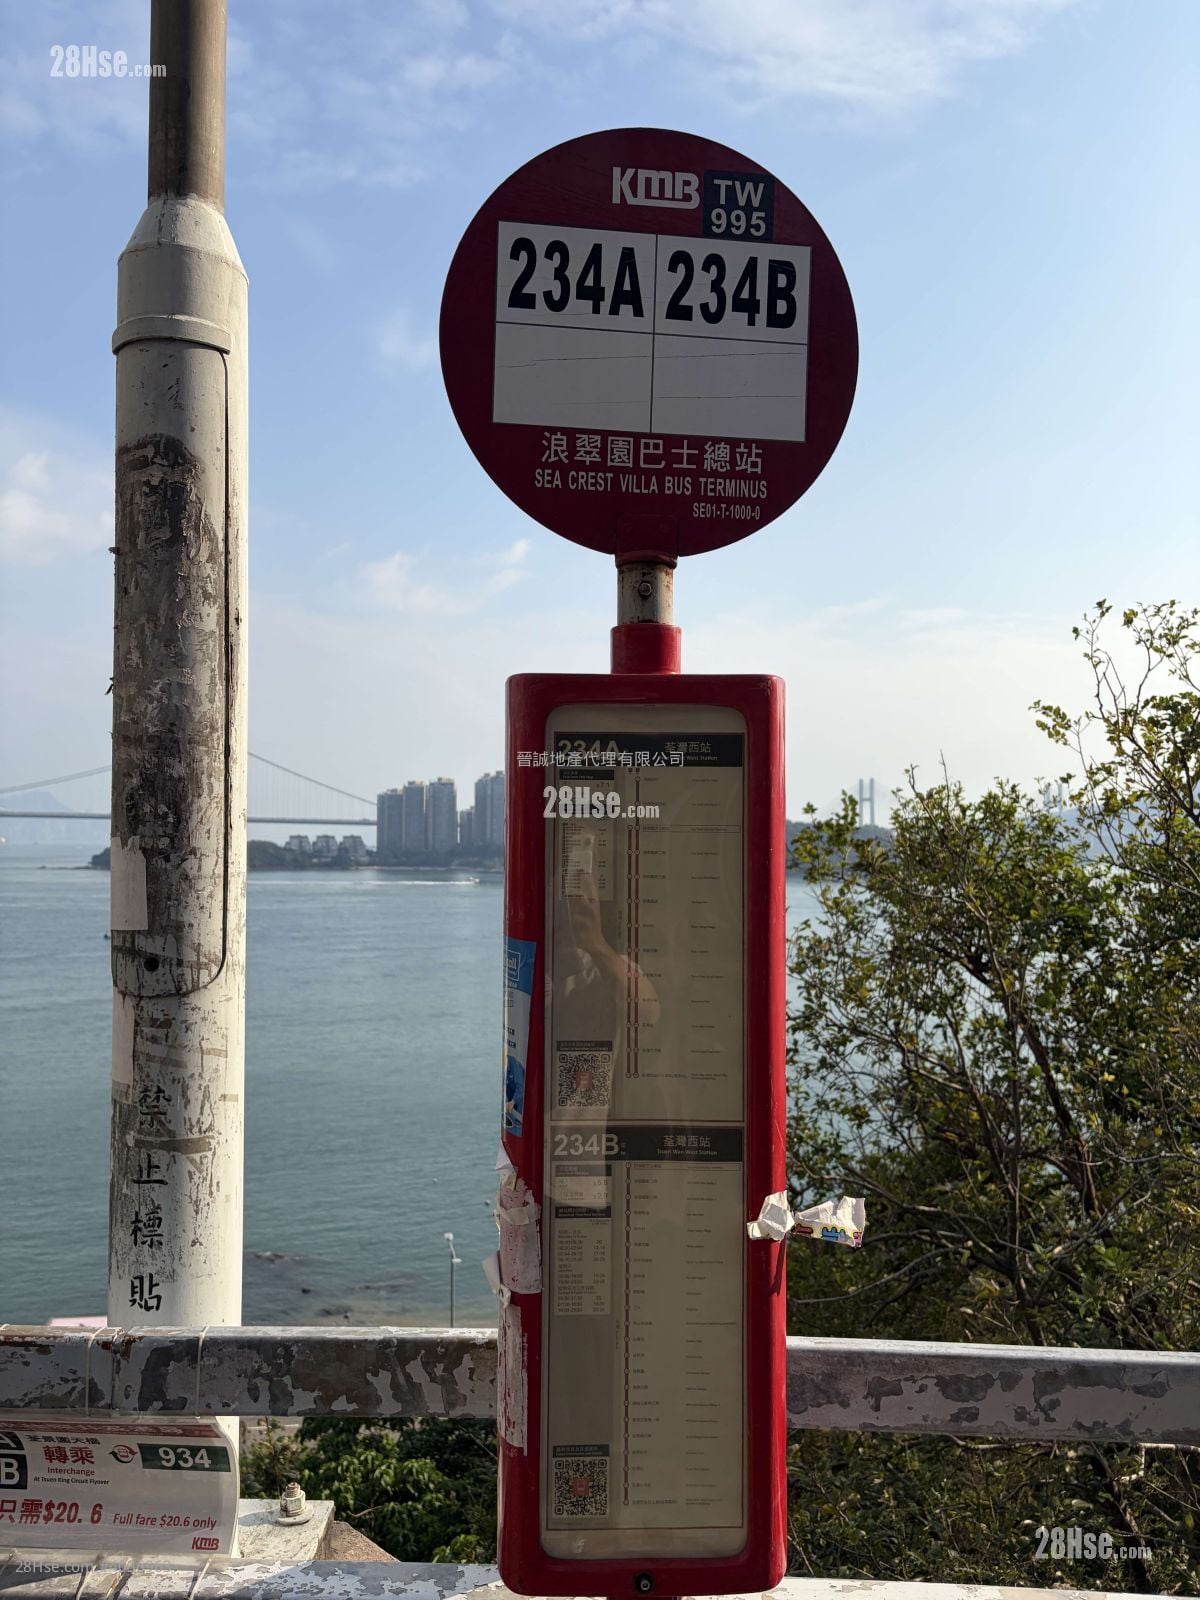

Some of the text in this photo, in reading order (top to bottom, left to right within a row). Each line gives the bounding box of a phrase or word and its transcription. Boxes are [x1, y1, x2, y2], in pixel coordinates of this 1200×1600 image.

[713, 178, 765, 207] TW
[710, 208, 766, 237] 995
[507, 236, 645, 318] 234A
[665, 250, 797, 329] 234B
[541, 431, 763, 475] 浪翠園巴士總站
[534, 467, 768, 500] SEA CREST VILLA BUS TERMINUS
[692, 502, 761, 521] SE01-T-1000-0
[553, 1133, 620, 1157] 234B
[43, 1445, 96, 1465] 轉乘
[158, 1446, 212, 1469] 934
[0, 1457, 20, 1486] B
[47, 1466, 96, 1477] Interchange
[113, 1513, 217, 1530] Full fare $20.6 only
